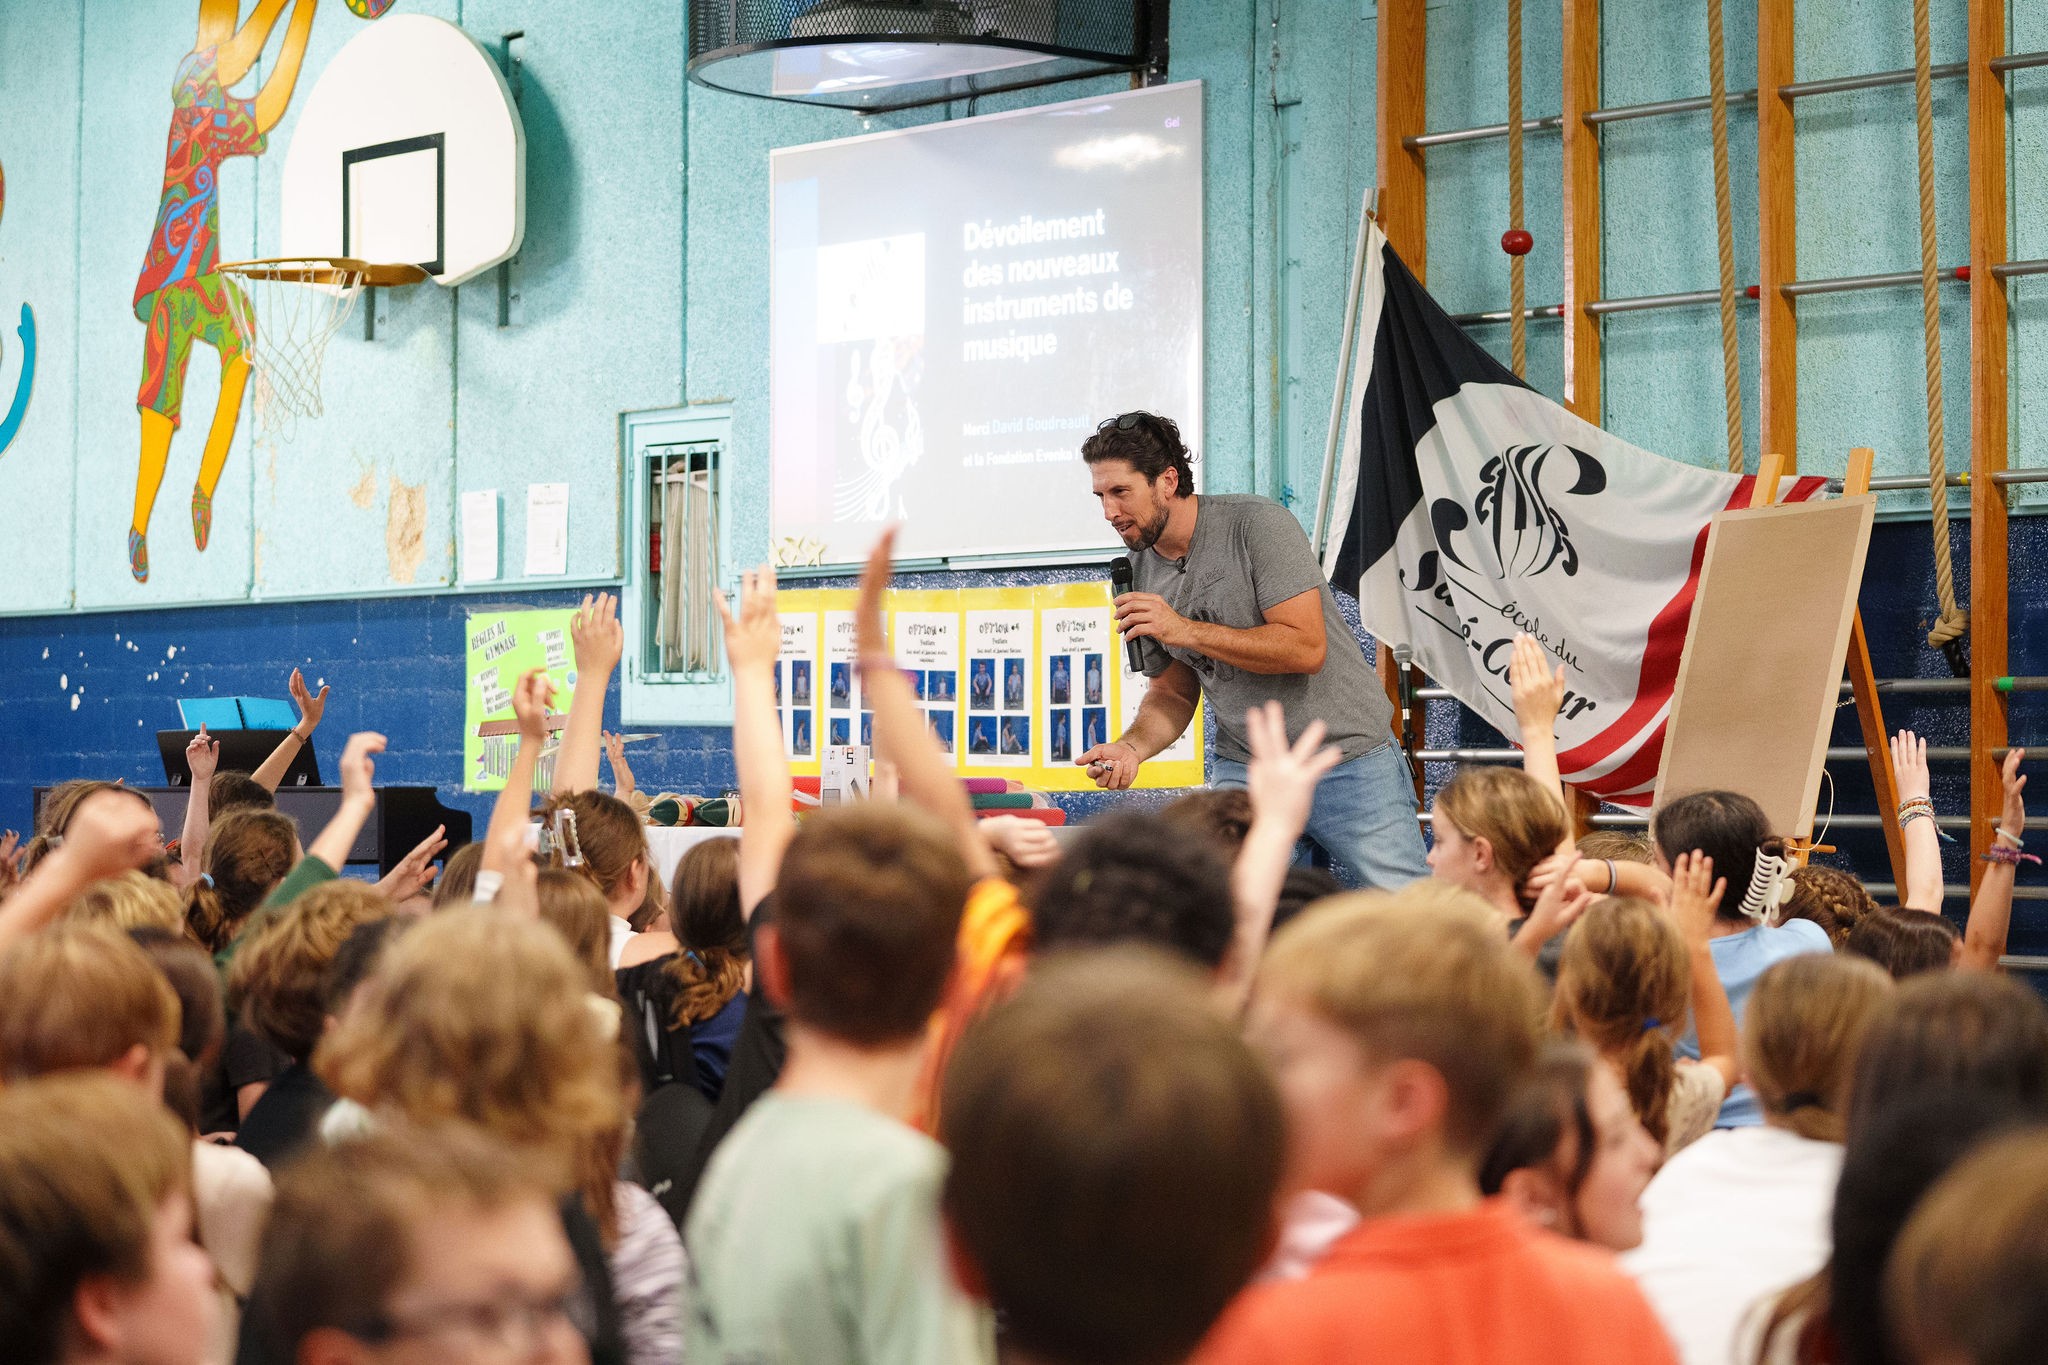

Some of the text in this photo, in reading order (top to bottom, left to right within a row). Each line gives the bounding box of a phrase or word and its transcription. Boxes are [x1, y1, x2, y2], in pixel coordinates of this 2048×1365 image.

[963, 208, 1105, 251] Dévoilement
[963, 251, 1120, 288] des nouveaux
[963, 281, 1134, 325] instruments de
[963, 329, 1058, 362] musique
[963, 415, 1091, 436] Merci David Goudreault
[963, 454, 971, 467] et
[974, 453, 984, 466] la
[986, 450, 1034, 465] Fondation
[1500, 601, 1584, 673] école du
